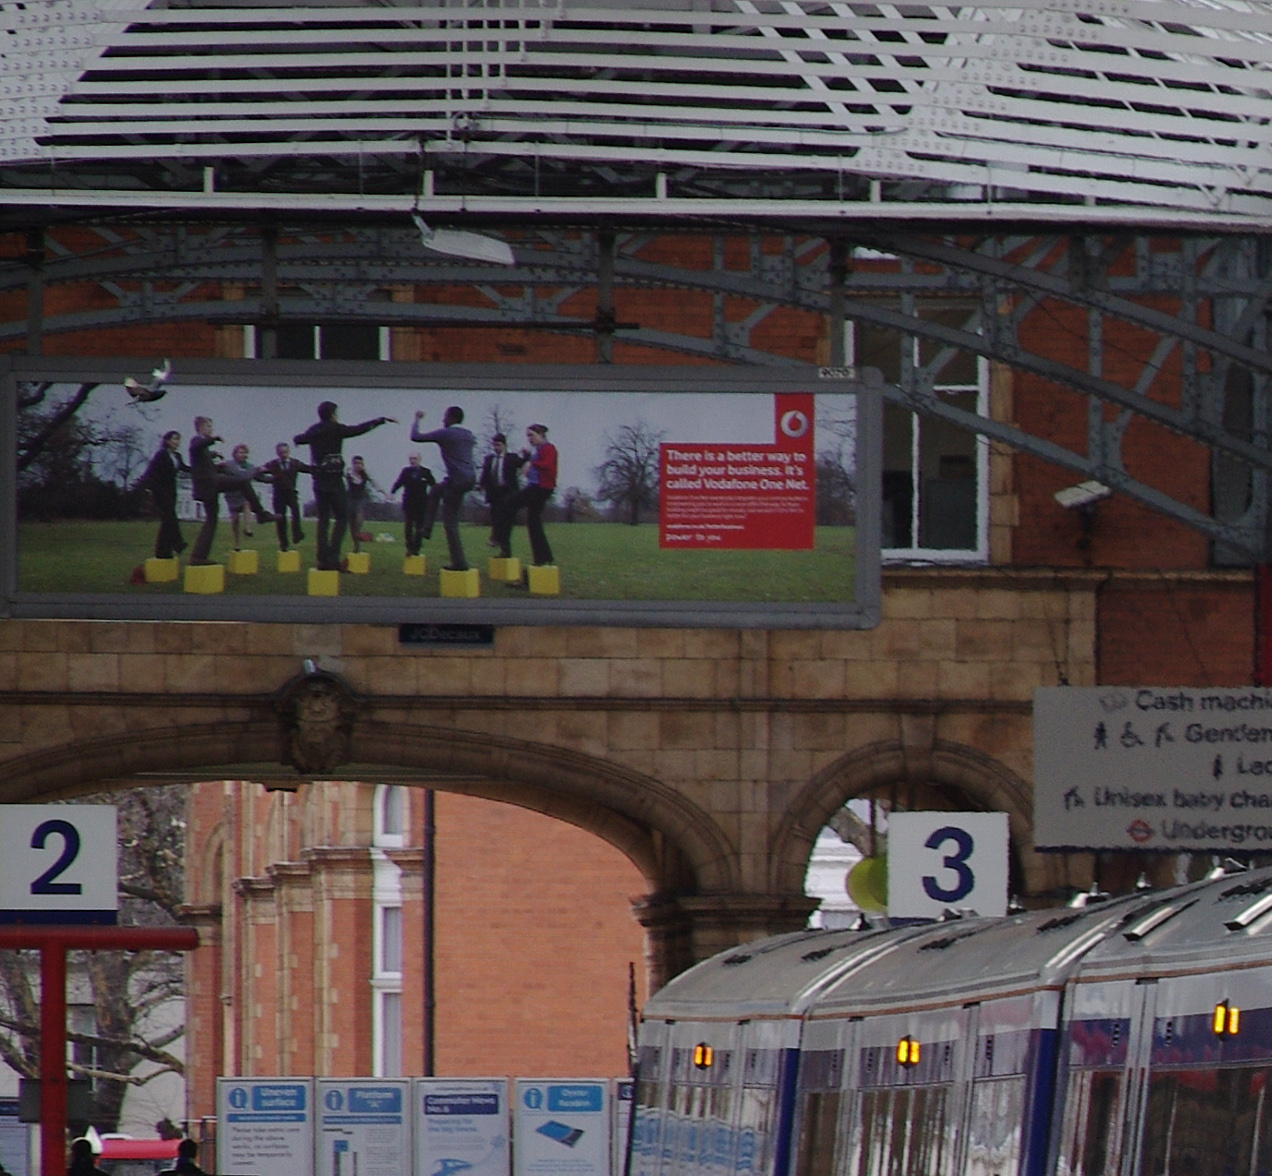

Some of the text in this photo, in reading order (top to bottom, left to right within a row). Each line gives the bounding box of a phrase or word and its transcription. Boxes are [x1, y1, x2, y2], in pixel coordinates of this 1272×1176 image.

[666, 449, 807, 464] There is a better way to
[666, 464, 804, 477] build your business. It's
[666, 478, 810, 490] called Vodafone One Net.
[666, 533, 692, 542] power
[1135, 690, 1194, 711] Cash
[1094, 786, 1167, 808] Unisex
[1173, 788, 1224, 812] baby
[30, 819, 82, 895] 2
[922, 826, 974, 903] 3
